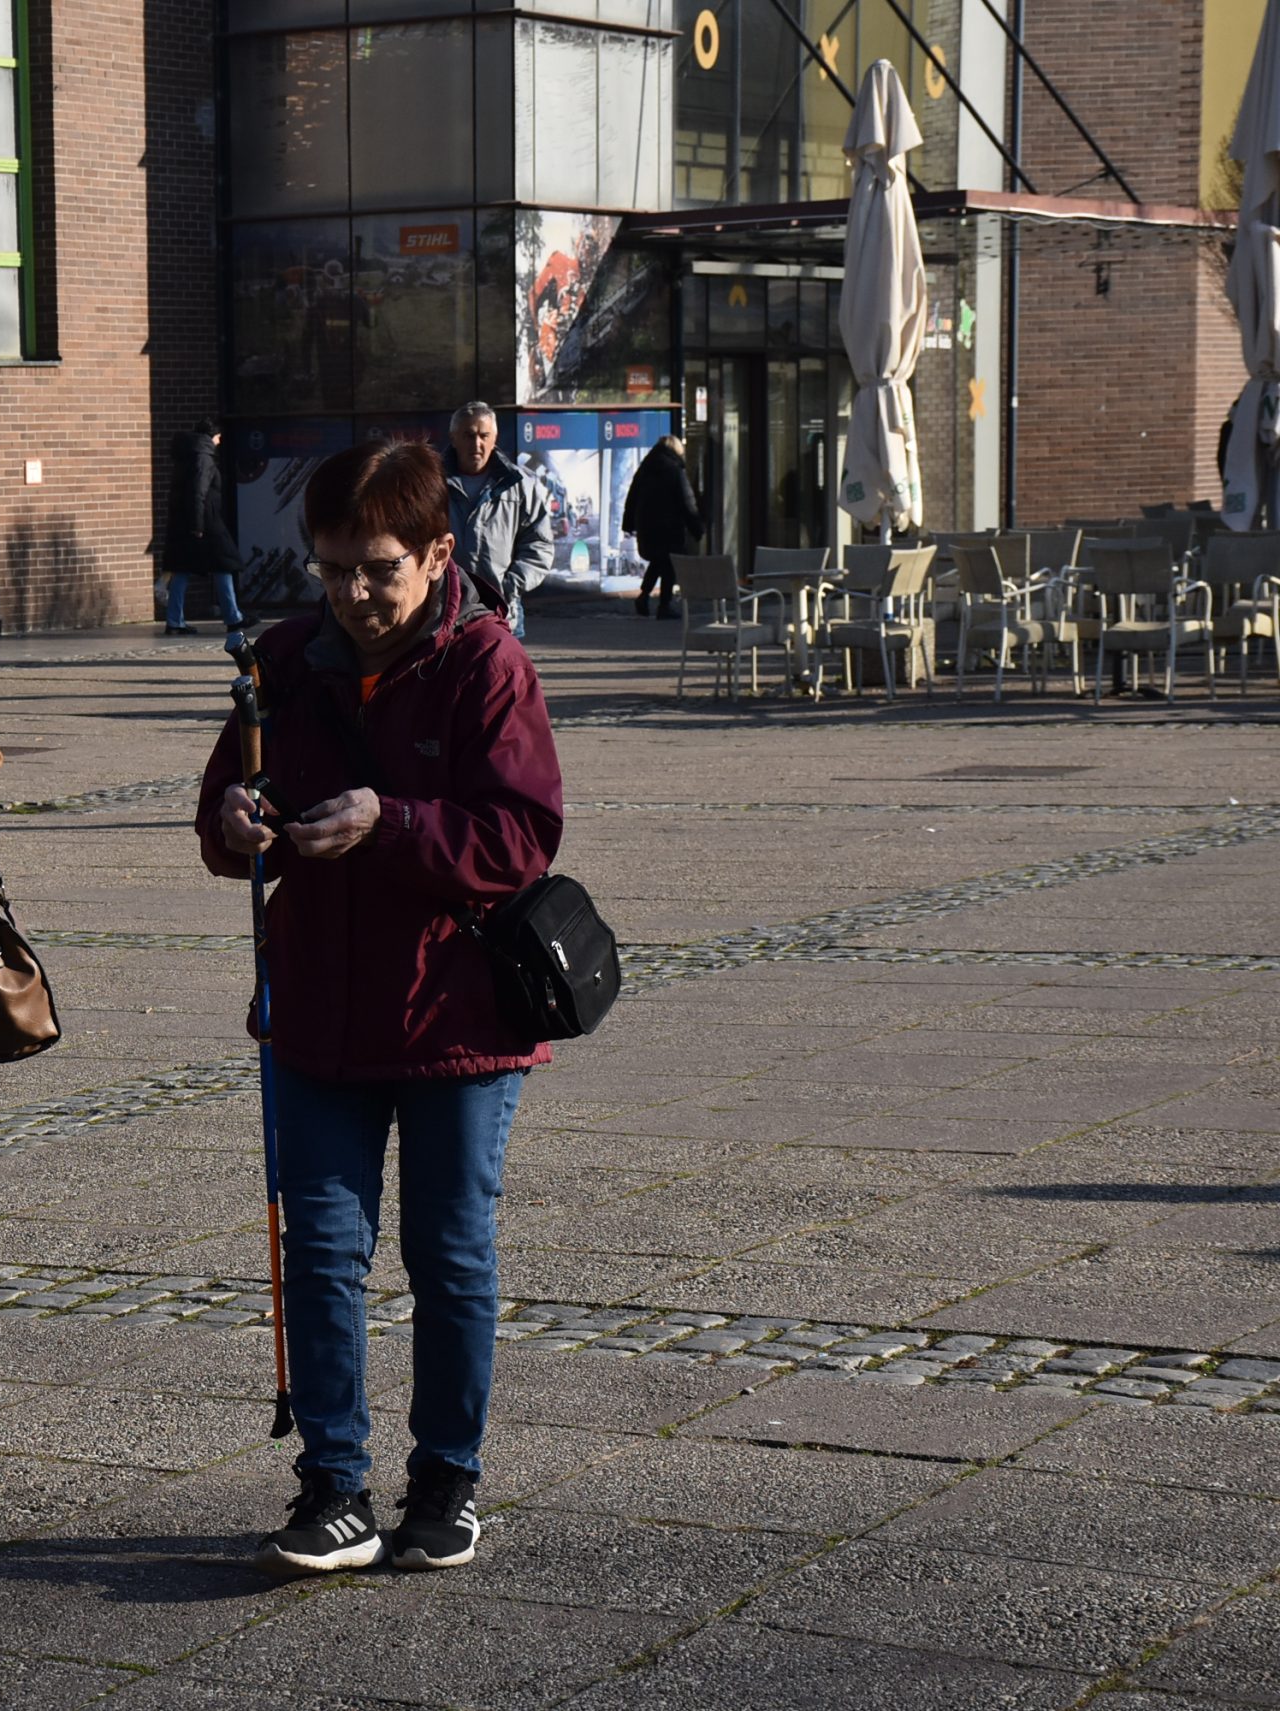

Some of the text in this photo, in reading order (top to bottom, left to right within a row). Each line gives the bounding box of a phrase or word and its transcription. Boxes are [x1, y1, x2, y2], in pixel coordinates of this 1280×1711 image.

[406, 232, 453, 248] STIHL
[535, 424, 562, 440] BOSCH
[615, 422, 640, 438] BOSCH
